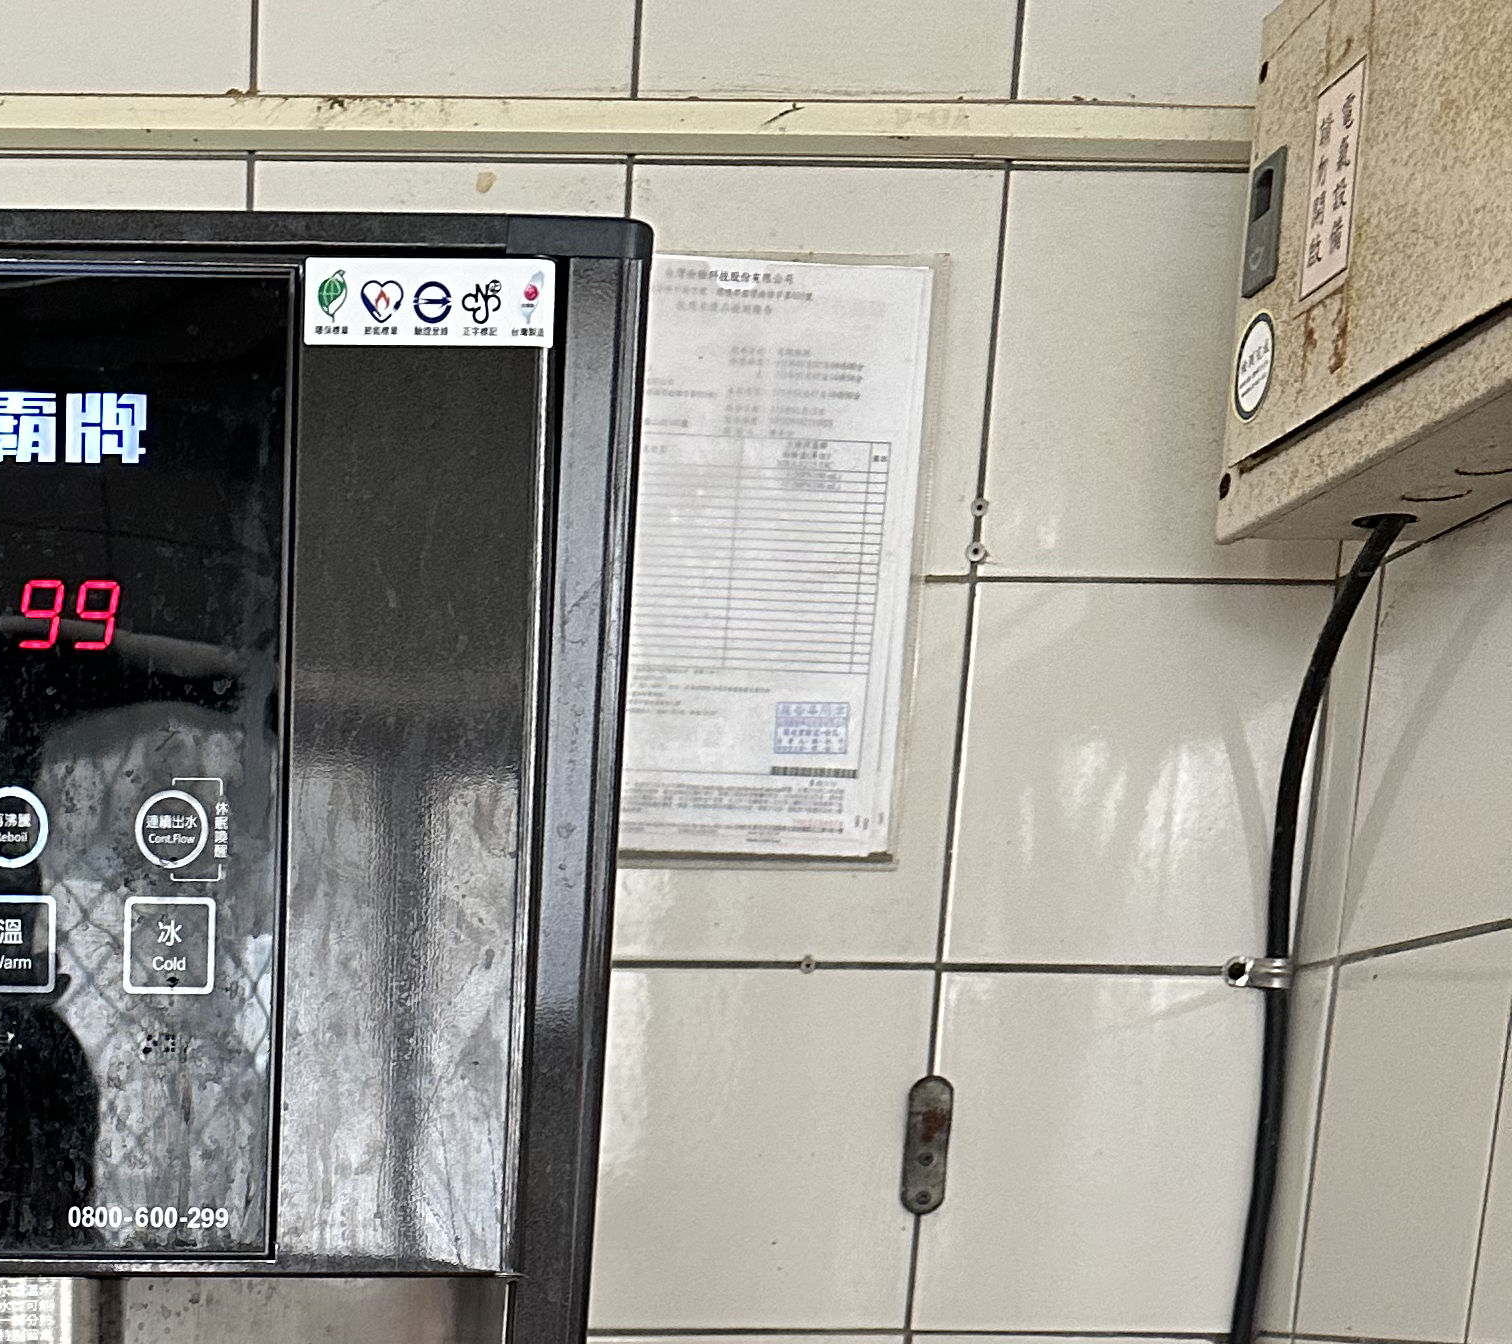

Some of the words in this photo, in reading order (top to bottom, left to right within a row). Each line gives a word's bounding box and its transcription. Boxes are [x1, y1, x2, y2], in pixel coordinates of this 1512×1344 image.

[18, 578, 121, 651] 99
[157, 920, 183, 947] 冰
[152, 956, 187, 971] Cold
[67, 1205, 230, 1230] 0800-600-299
